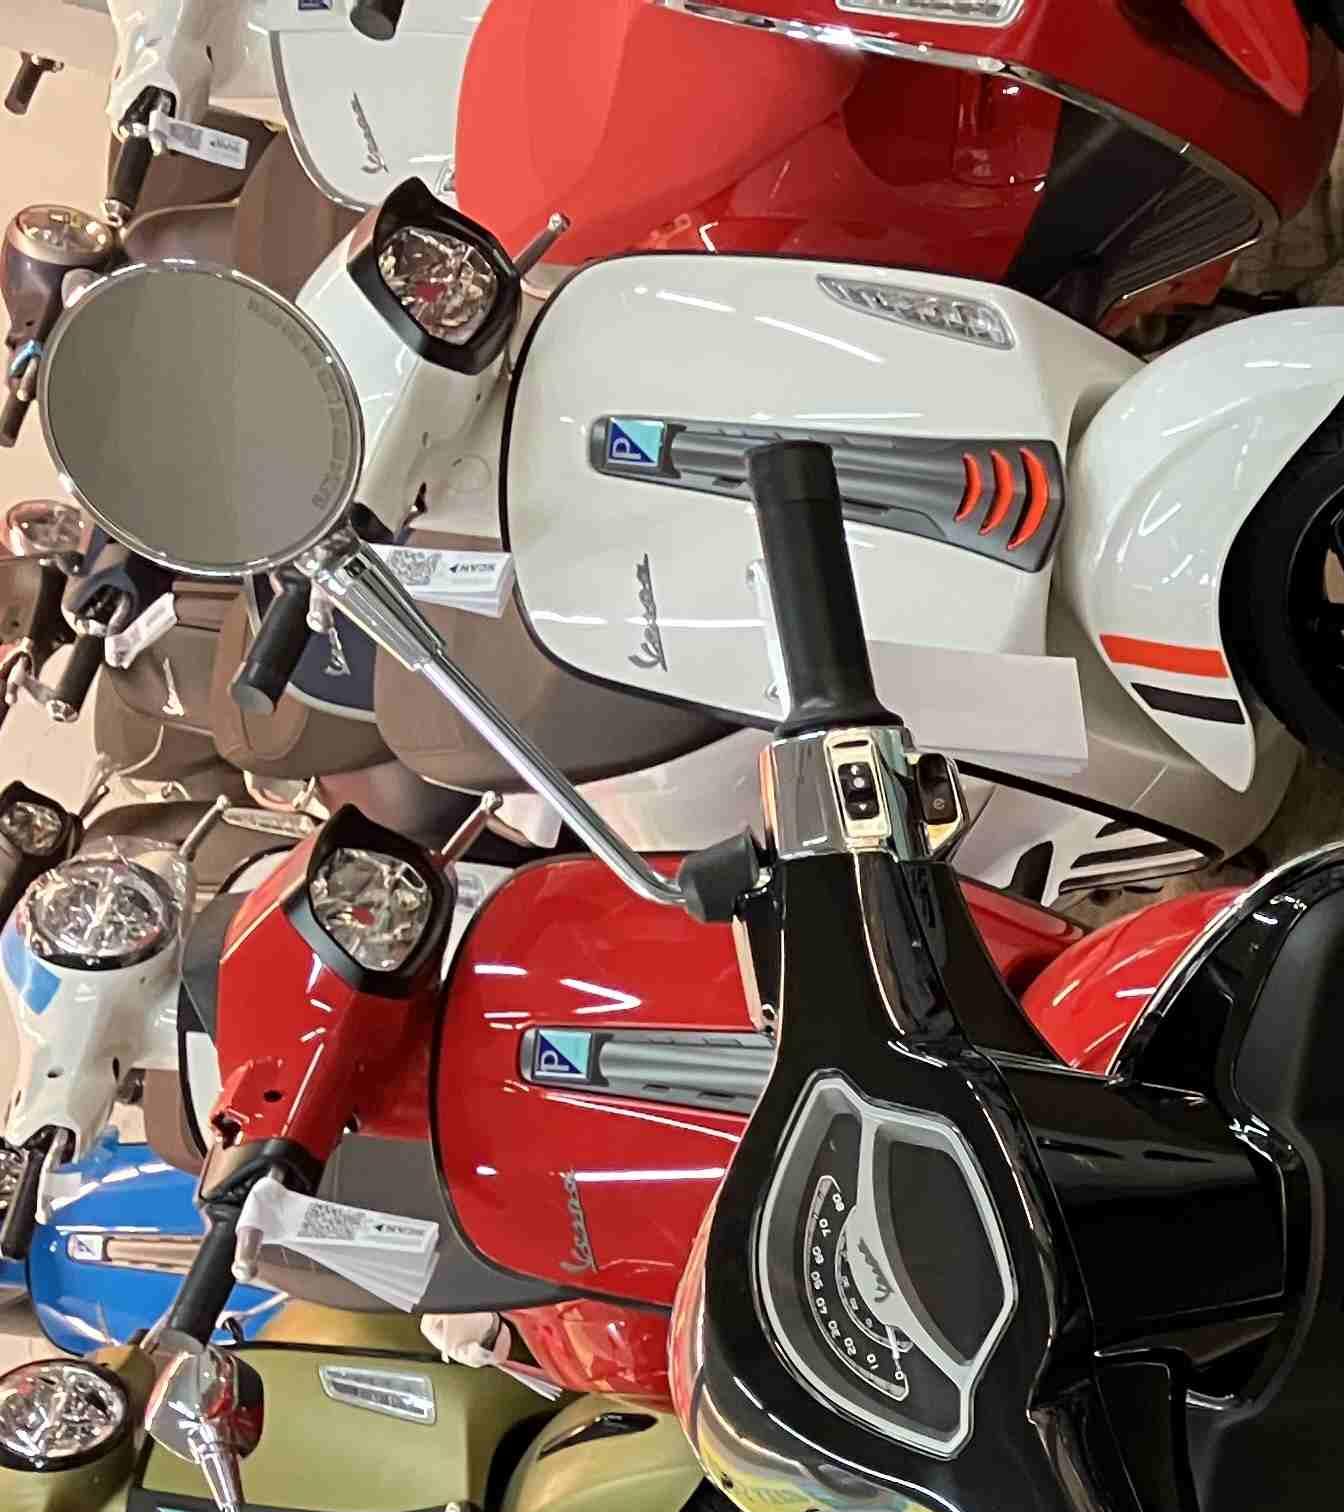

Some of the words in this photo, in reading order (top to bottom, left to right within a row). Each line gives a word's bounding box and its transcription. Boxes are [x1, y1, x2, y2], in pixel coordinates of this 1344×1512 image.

[627, 553, 668, 673] Vespa
[559, 1168, 599, 1274] Vespa
[818, 1218, 832, 1237] 70
[857, 1236, 895, 1303] Vespa
[815, 1297, 828, 1314] 40
[844, 1337, 857, 1356] 20
[866, 1353, 879, 1370] 10
[894, 1371, 904, 1380] 0
